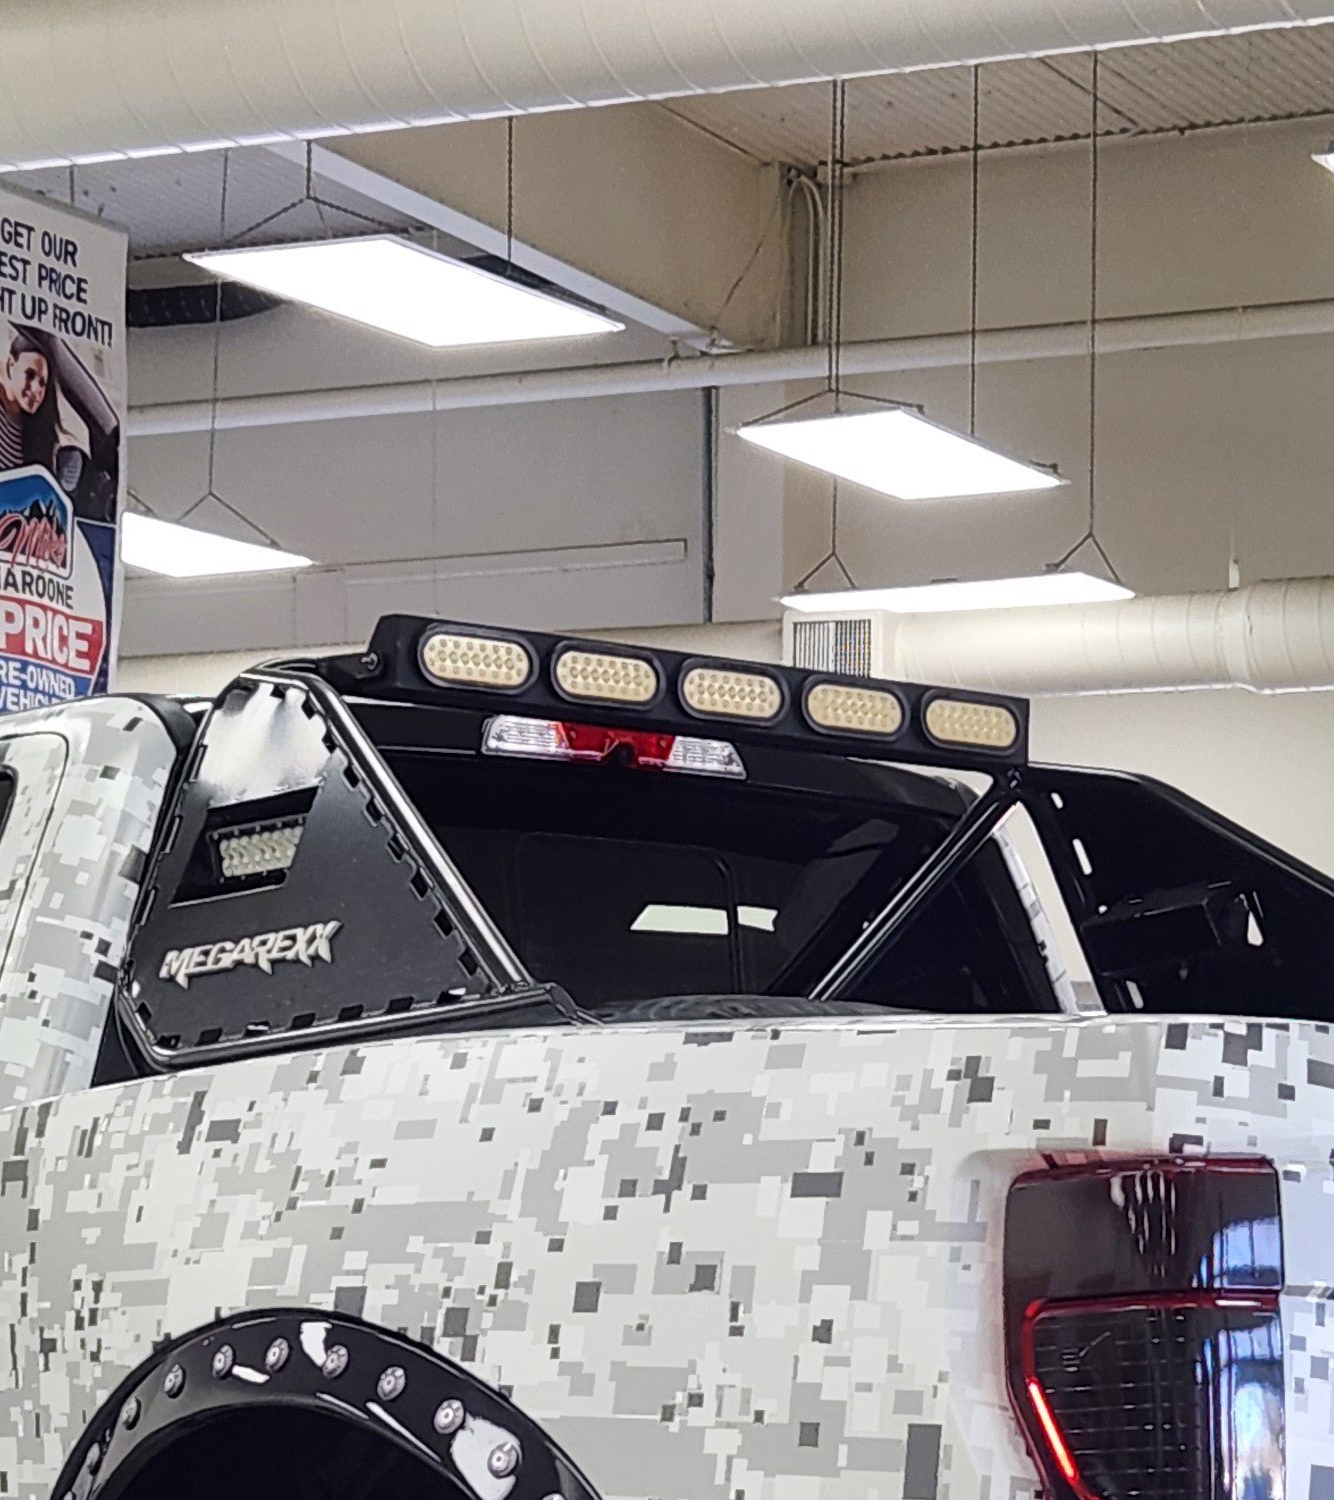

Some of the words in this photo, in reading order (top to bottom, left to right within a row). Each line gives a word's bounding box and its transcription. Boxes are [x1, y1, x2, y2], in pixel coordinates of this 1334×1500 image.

[0, 216, 36, 252] GET
[40, 230, 78, 268] OUR
[37, 262, 88, 305] PRICE
[21, 292, 48, 323] UP
[52, 302, 113, 348] FRONT!
[158, 920, 344, 990] MEGAREXX
